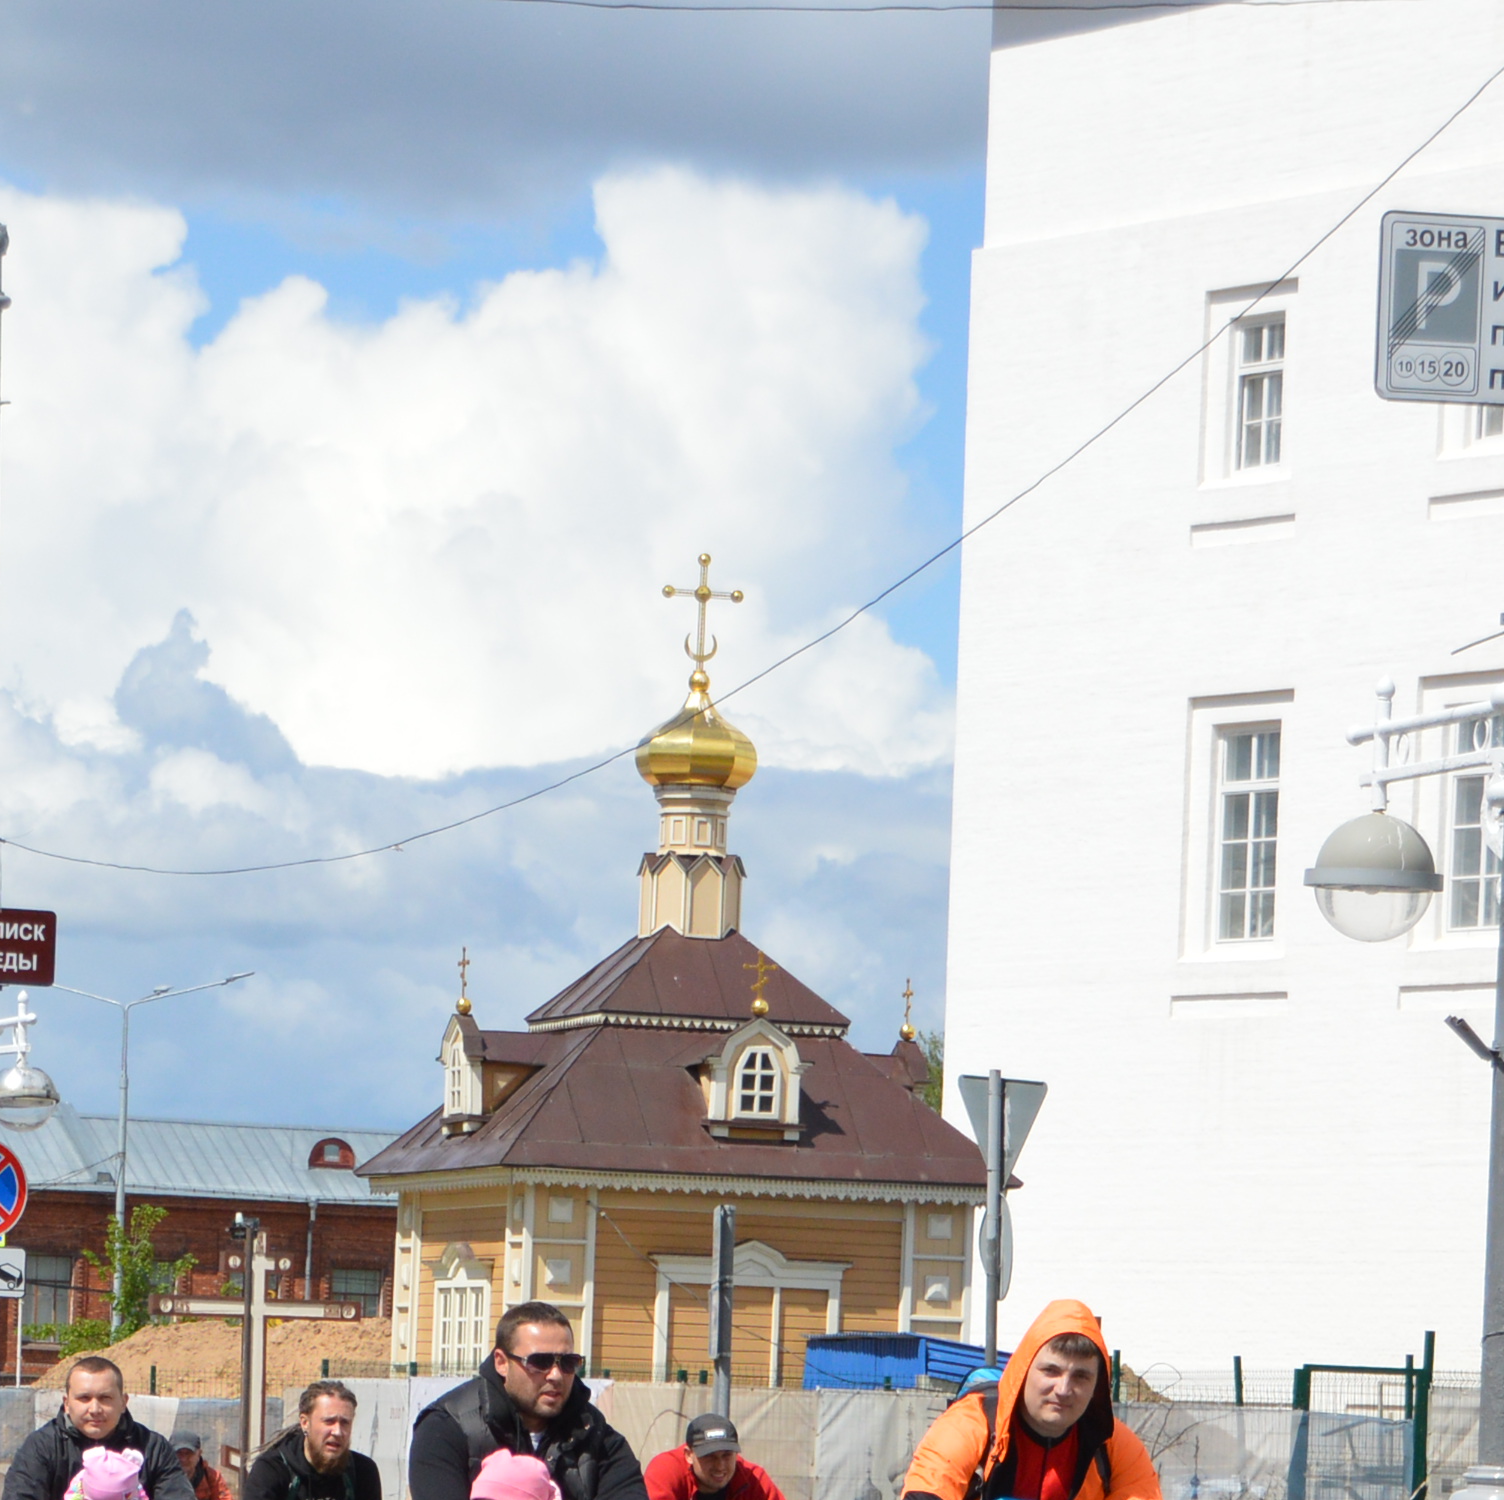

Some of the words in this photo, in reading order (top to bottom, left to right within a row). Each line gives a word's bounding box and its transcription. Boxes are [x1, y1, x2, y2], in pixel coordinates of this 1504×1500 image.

[1404, 229, 1469, 250] зона
[1397, 361, 1413, 374] 10
[1417, 359, 1437, 376] 15
[1442, 360, 1465, 379] 20
